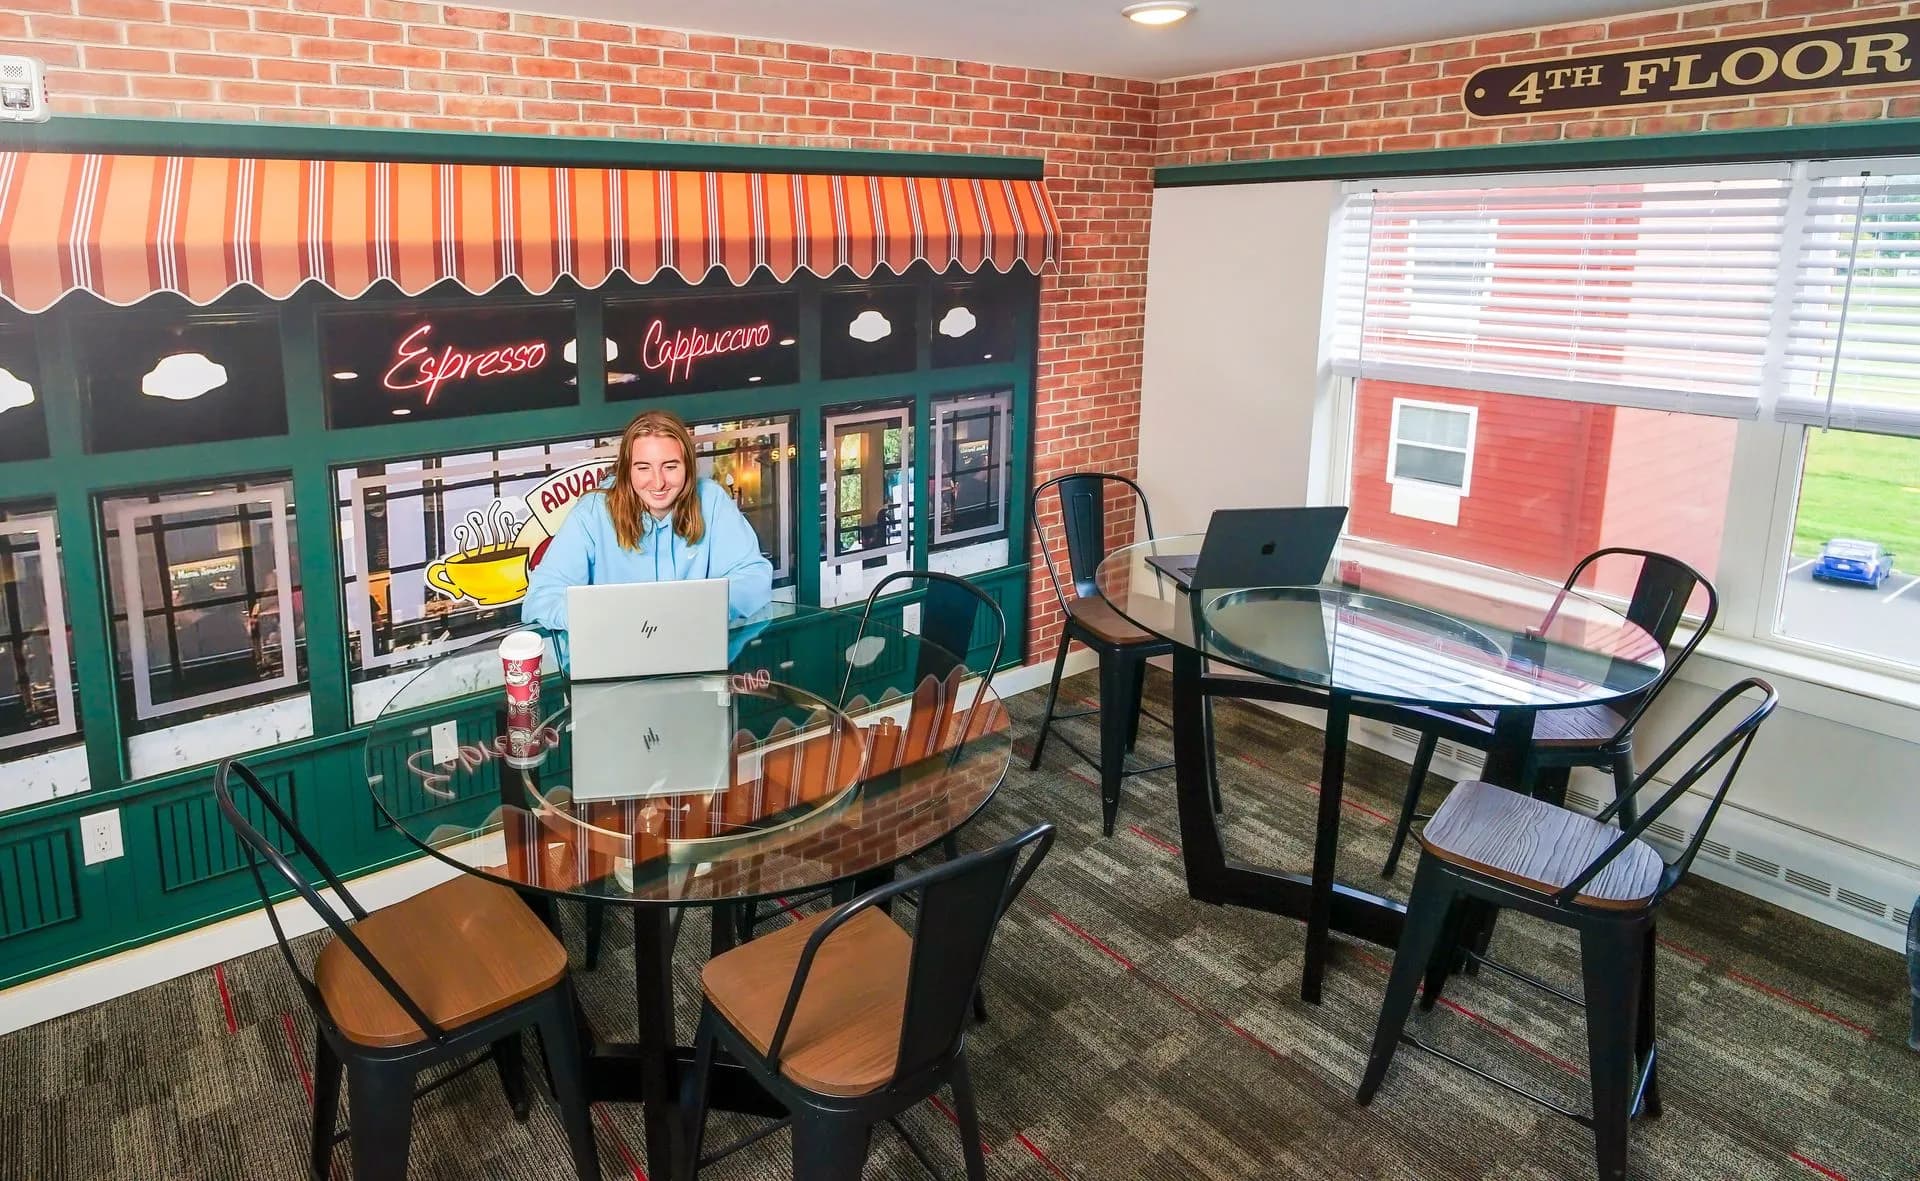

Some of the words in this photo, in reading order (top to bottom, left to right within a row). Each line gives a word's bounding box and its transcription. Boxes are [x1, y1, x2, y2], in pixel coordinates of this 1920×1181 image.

[1508, 64, 1604, 105] 4TH
[1619, 32, 1912, 96] FLOOR
[383, 324, 546, 405] Espresso
[643, 319, 770, 384] Cappuccino
[641, 620, 658, 639] hp
